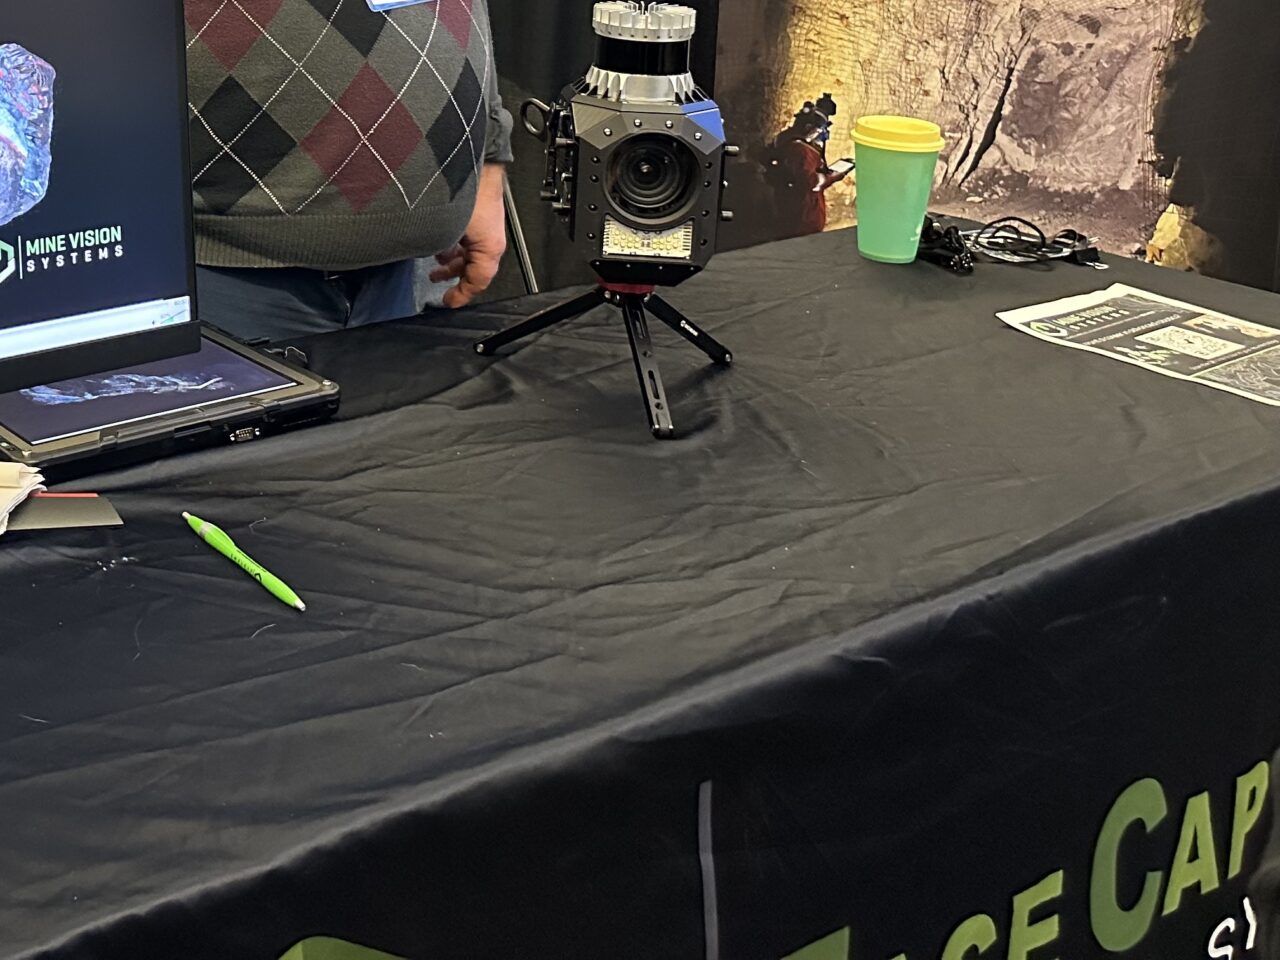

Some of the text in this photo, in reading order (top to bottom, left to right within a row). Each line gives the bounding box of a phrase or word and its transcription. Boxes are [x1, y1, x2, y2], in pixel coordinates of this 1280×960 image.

[25, 225, 122, 256] MINE VISION
[26, 244, 124, 272] SYSTEMS
